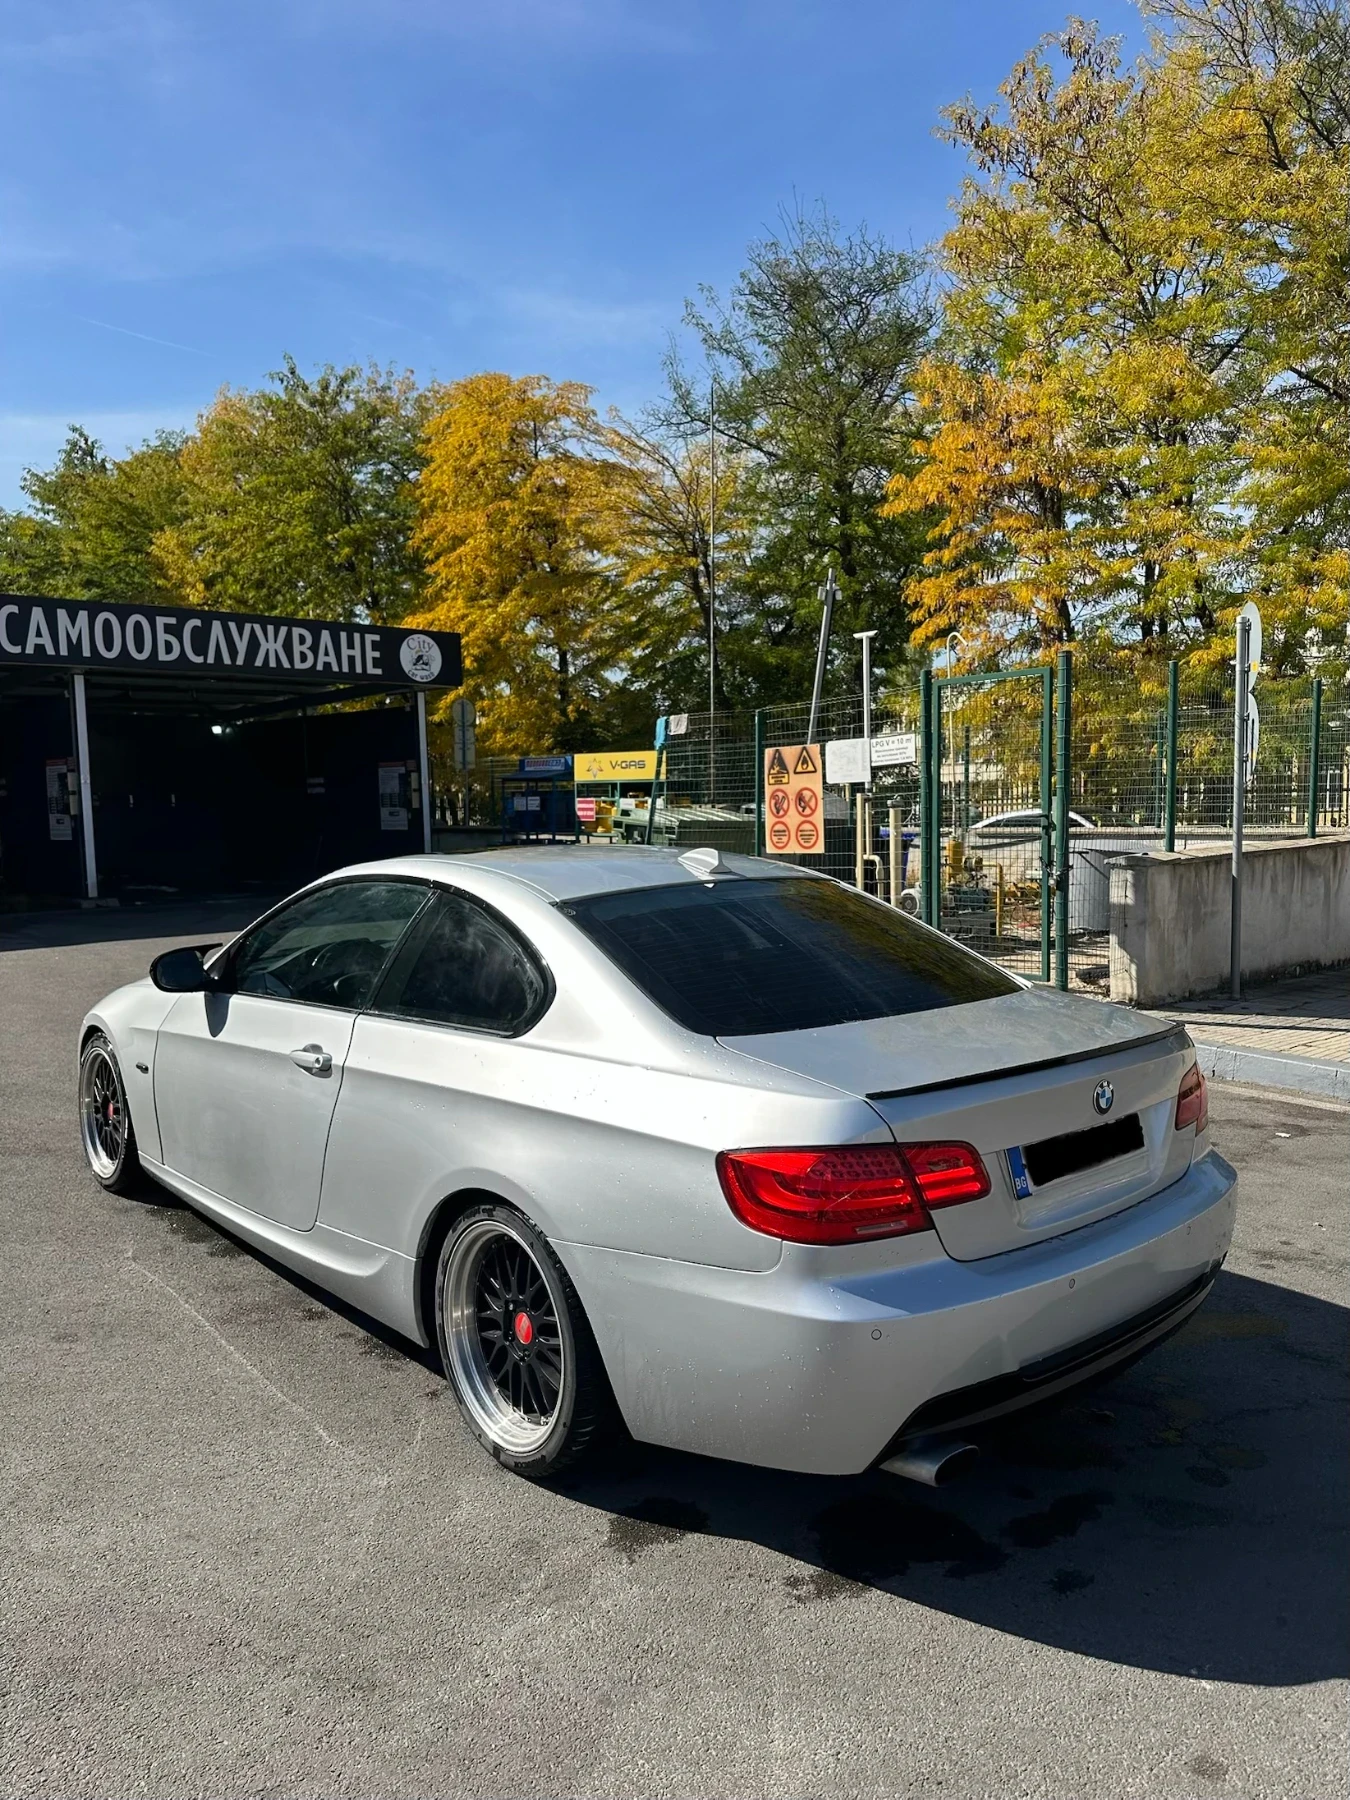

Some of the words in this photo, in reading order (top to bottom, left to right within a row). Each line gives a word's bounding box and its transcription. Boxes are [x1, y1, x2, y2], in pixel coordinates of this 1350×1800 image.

[0, 604, 383, 675] САМООБСЛУЖВАНЕ
[406, 637, 434, 653] City
[871, 740, 884, 748] LPG
[609, 760, 646, 770] V-GAS
[1015, 1176, 1026, 1190] BG
